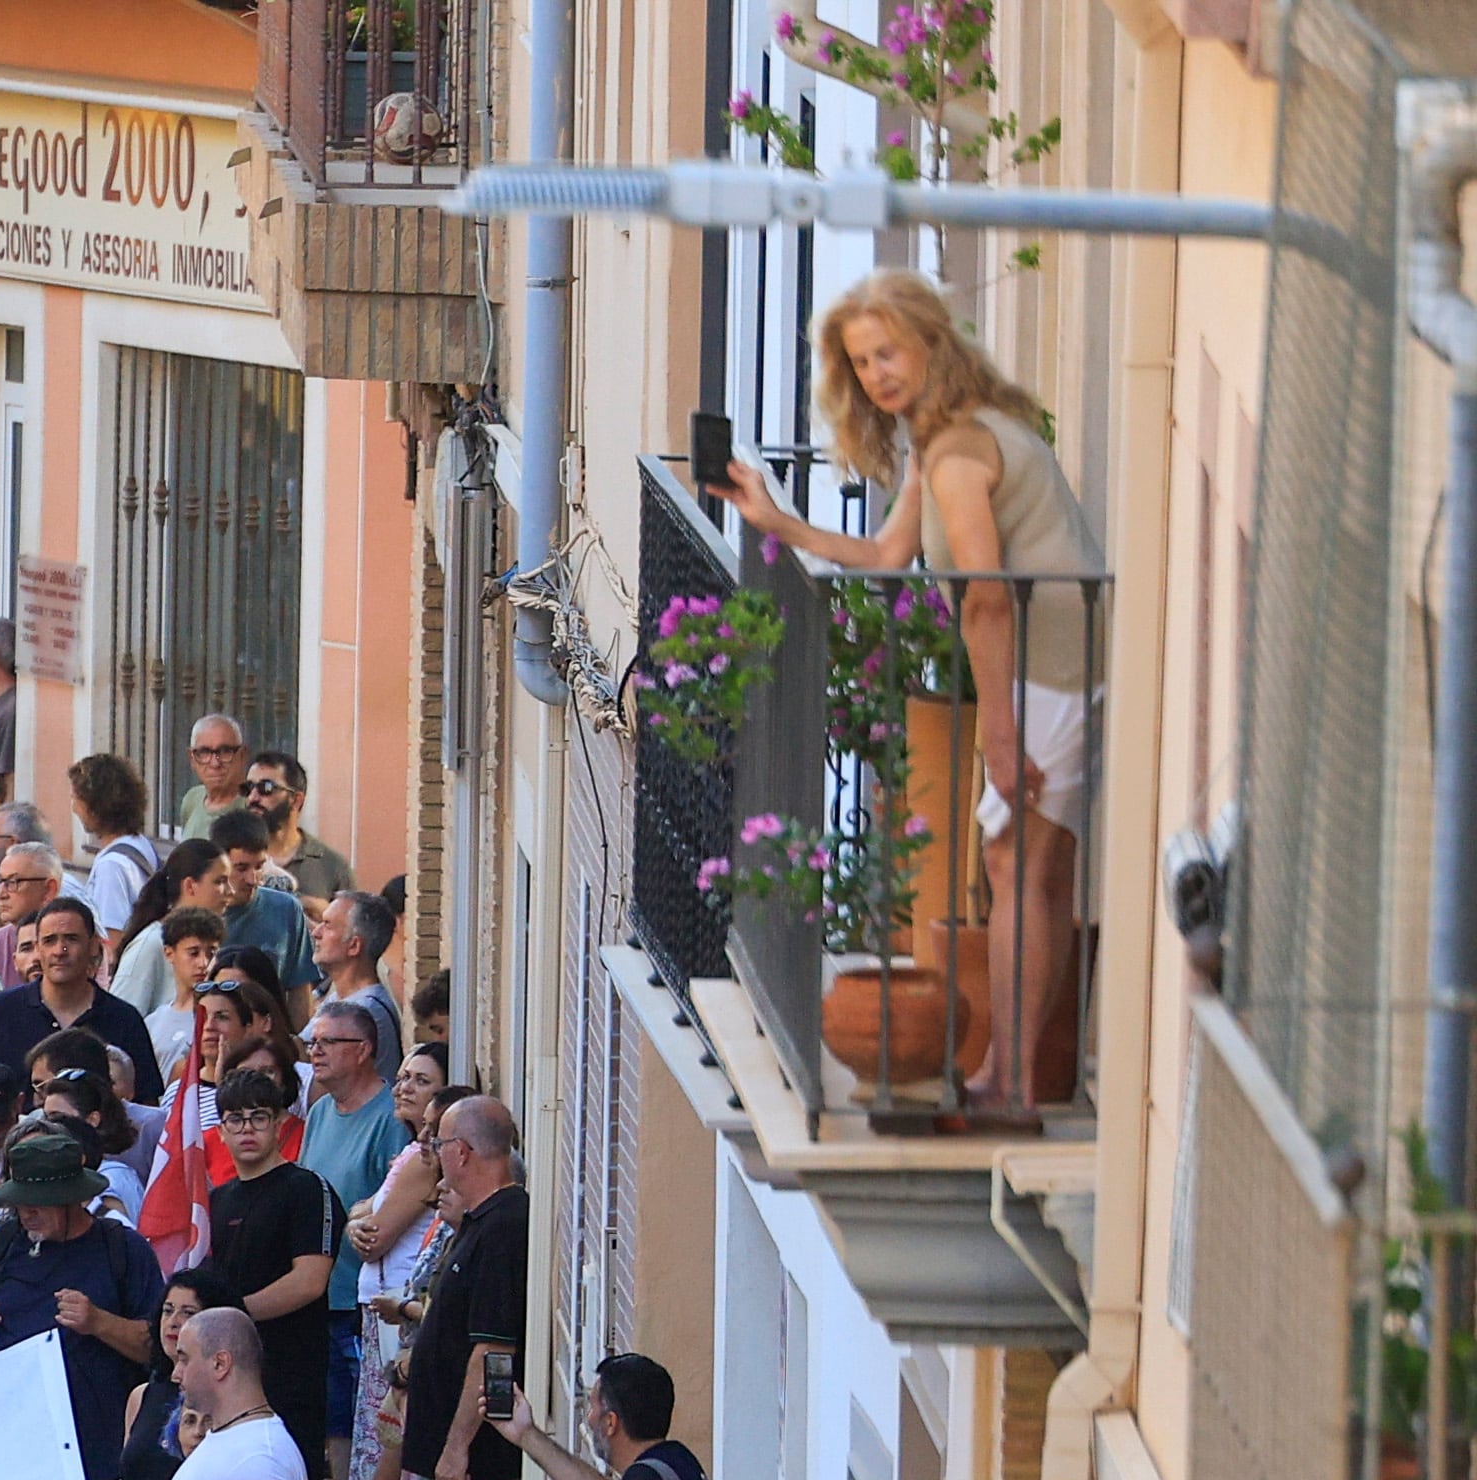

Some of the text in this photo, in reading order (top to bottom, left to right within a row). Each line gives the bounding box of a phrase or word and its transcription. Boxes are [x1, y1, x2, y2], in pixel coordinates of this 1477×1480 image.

[61, 229, 72, 268] Y
[81, 232, 159, 281] ASESORIA
[172, 243, 260, 296] INMOBILIA
